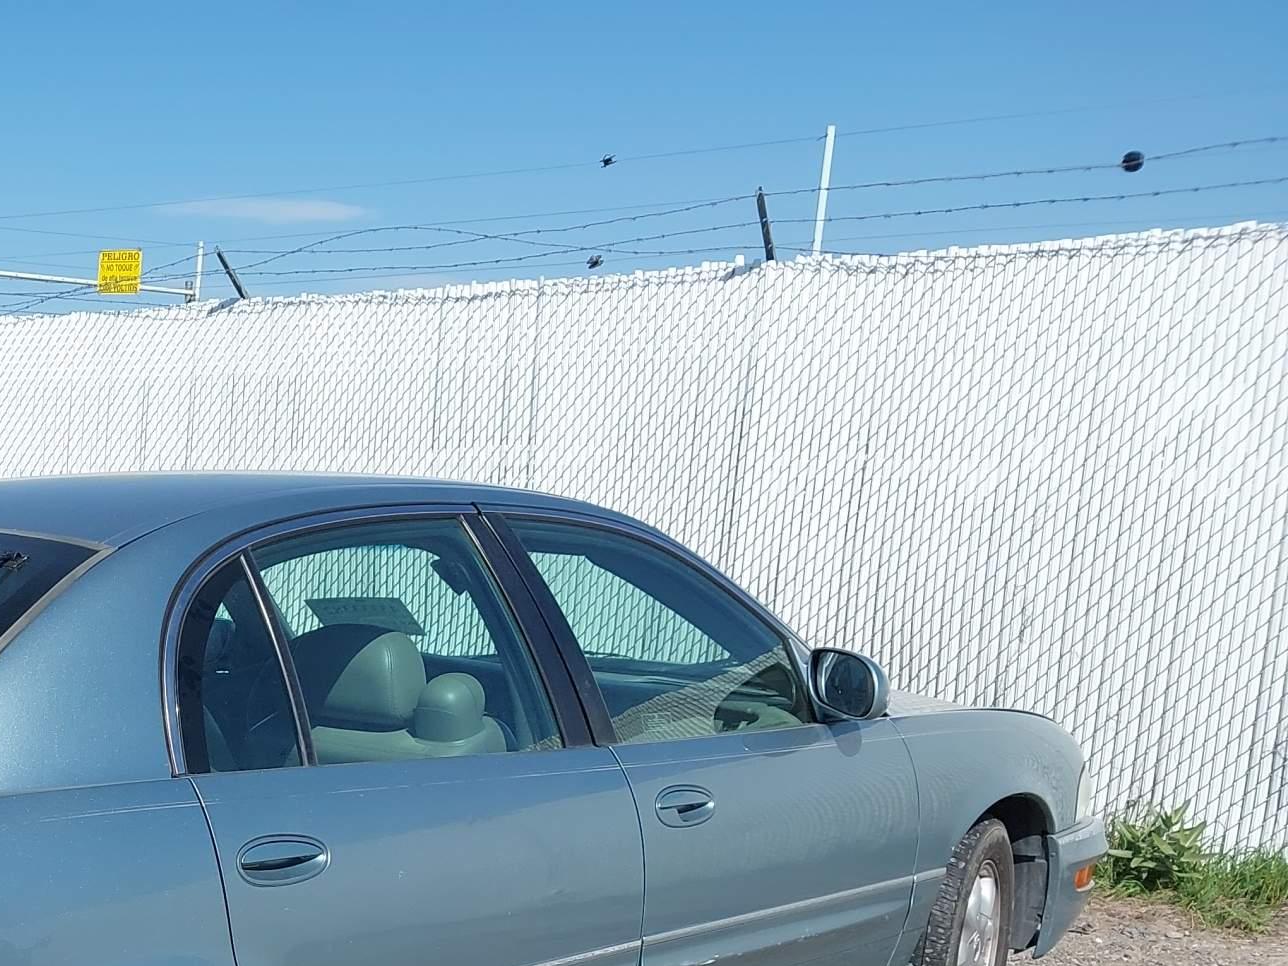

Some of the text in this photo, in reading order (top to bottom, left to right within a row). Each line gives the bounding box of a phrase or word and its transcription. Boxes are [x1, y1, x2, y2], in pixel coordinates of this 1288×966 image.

[102, 252, 140, 261] PELIGRO
[107, 263, 133, 271] NO TOQUE
